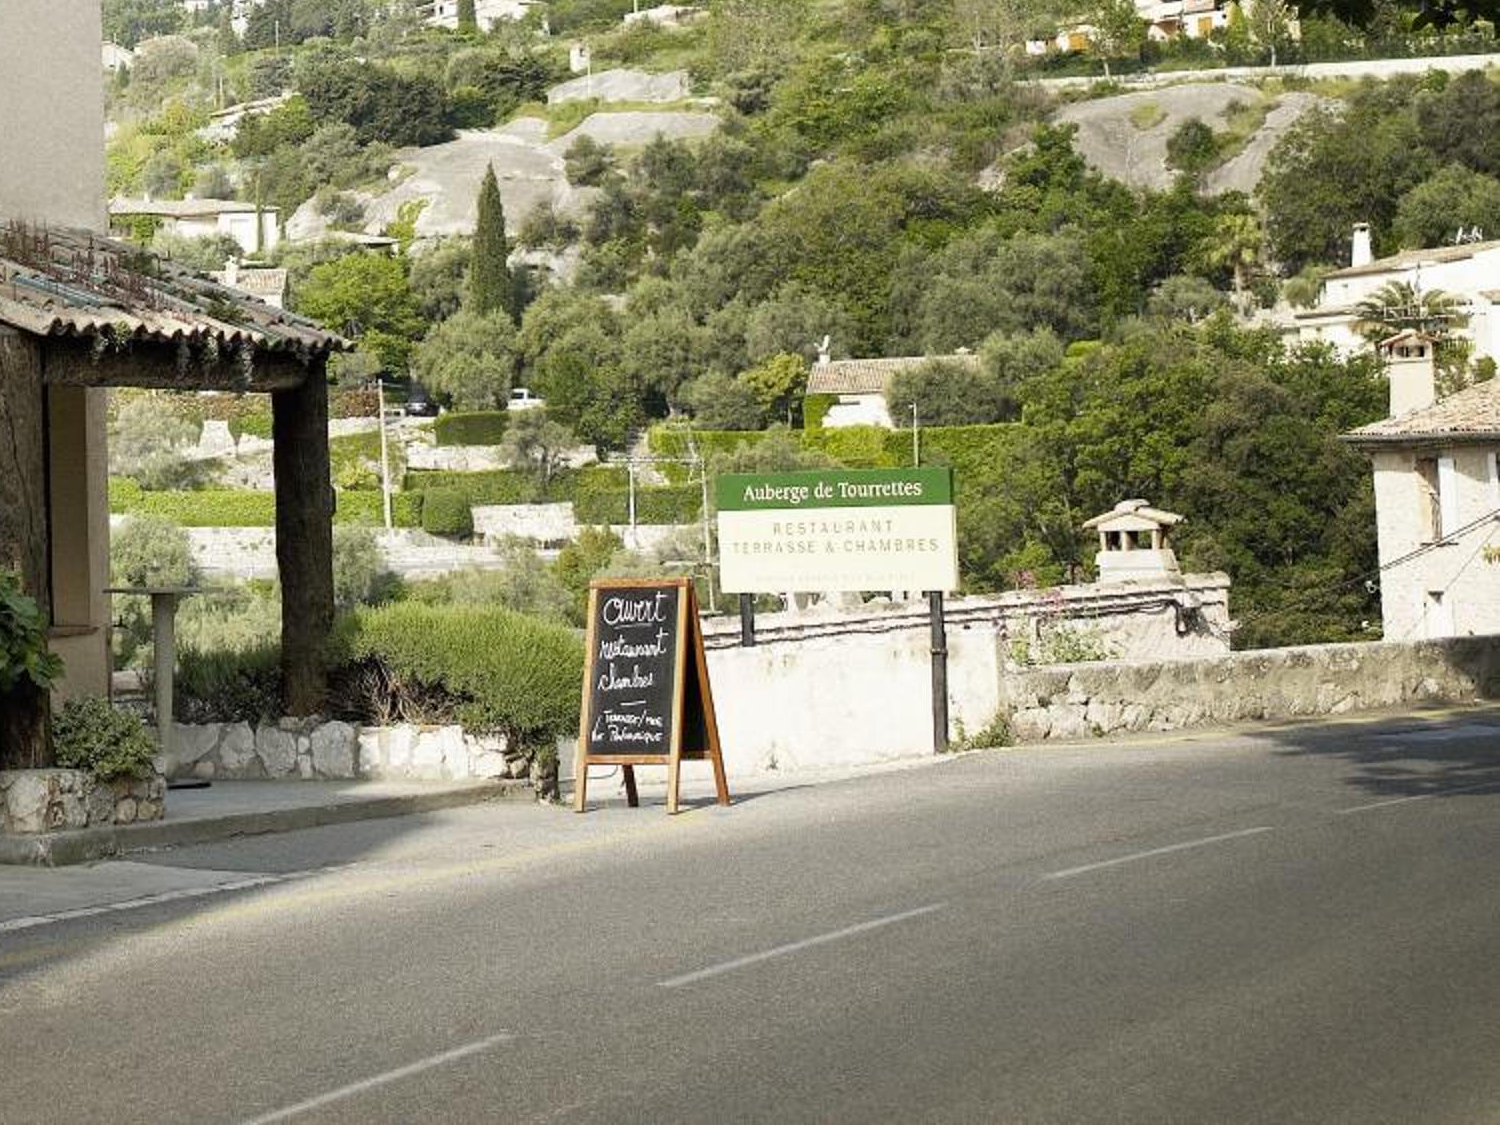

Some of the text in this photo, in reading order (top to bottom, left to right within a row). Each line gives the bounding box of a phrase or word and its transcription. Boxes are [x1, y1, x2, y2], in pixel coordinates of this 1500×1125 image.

[743, 480, 923, 503] Auberge de Tourrettes
[773, 520, 893, 536] RESTAURANT
[732, 538, 941, 556] TERRASSE & CHAMBRES
